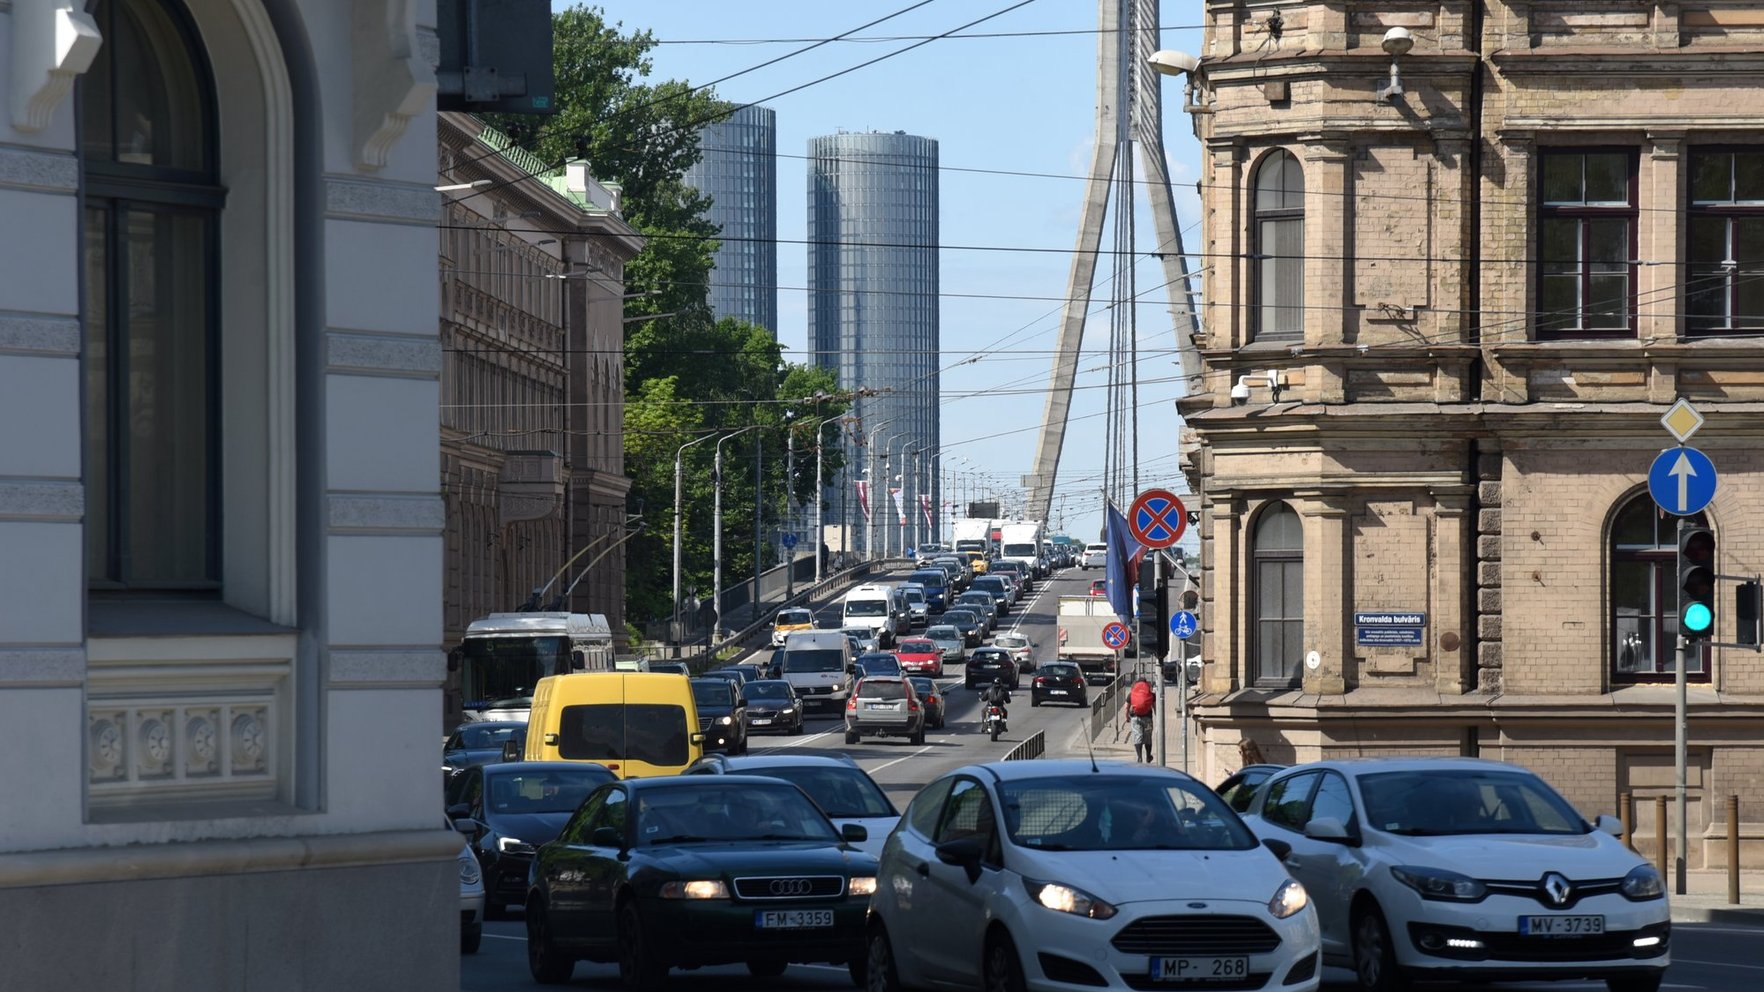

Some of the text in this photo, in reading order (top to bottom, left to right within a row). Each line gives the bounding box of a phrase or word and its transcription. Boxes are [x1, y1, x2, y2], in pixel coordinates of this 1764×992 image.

[1359, 615, 1421, 623] Kronvalda bulvāris
[766, 912, 831, 926] FM-3359
[1531, 918, 1602, 932] MV-3739
